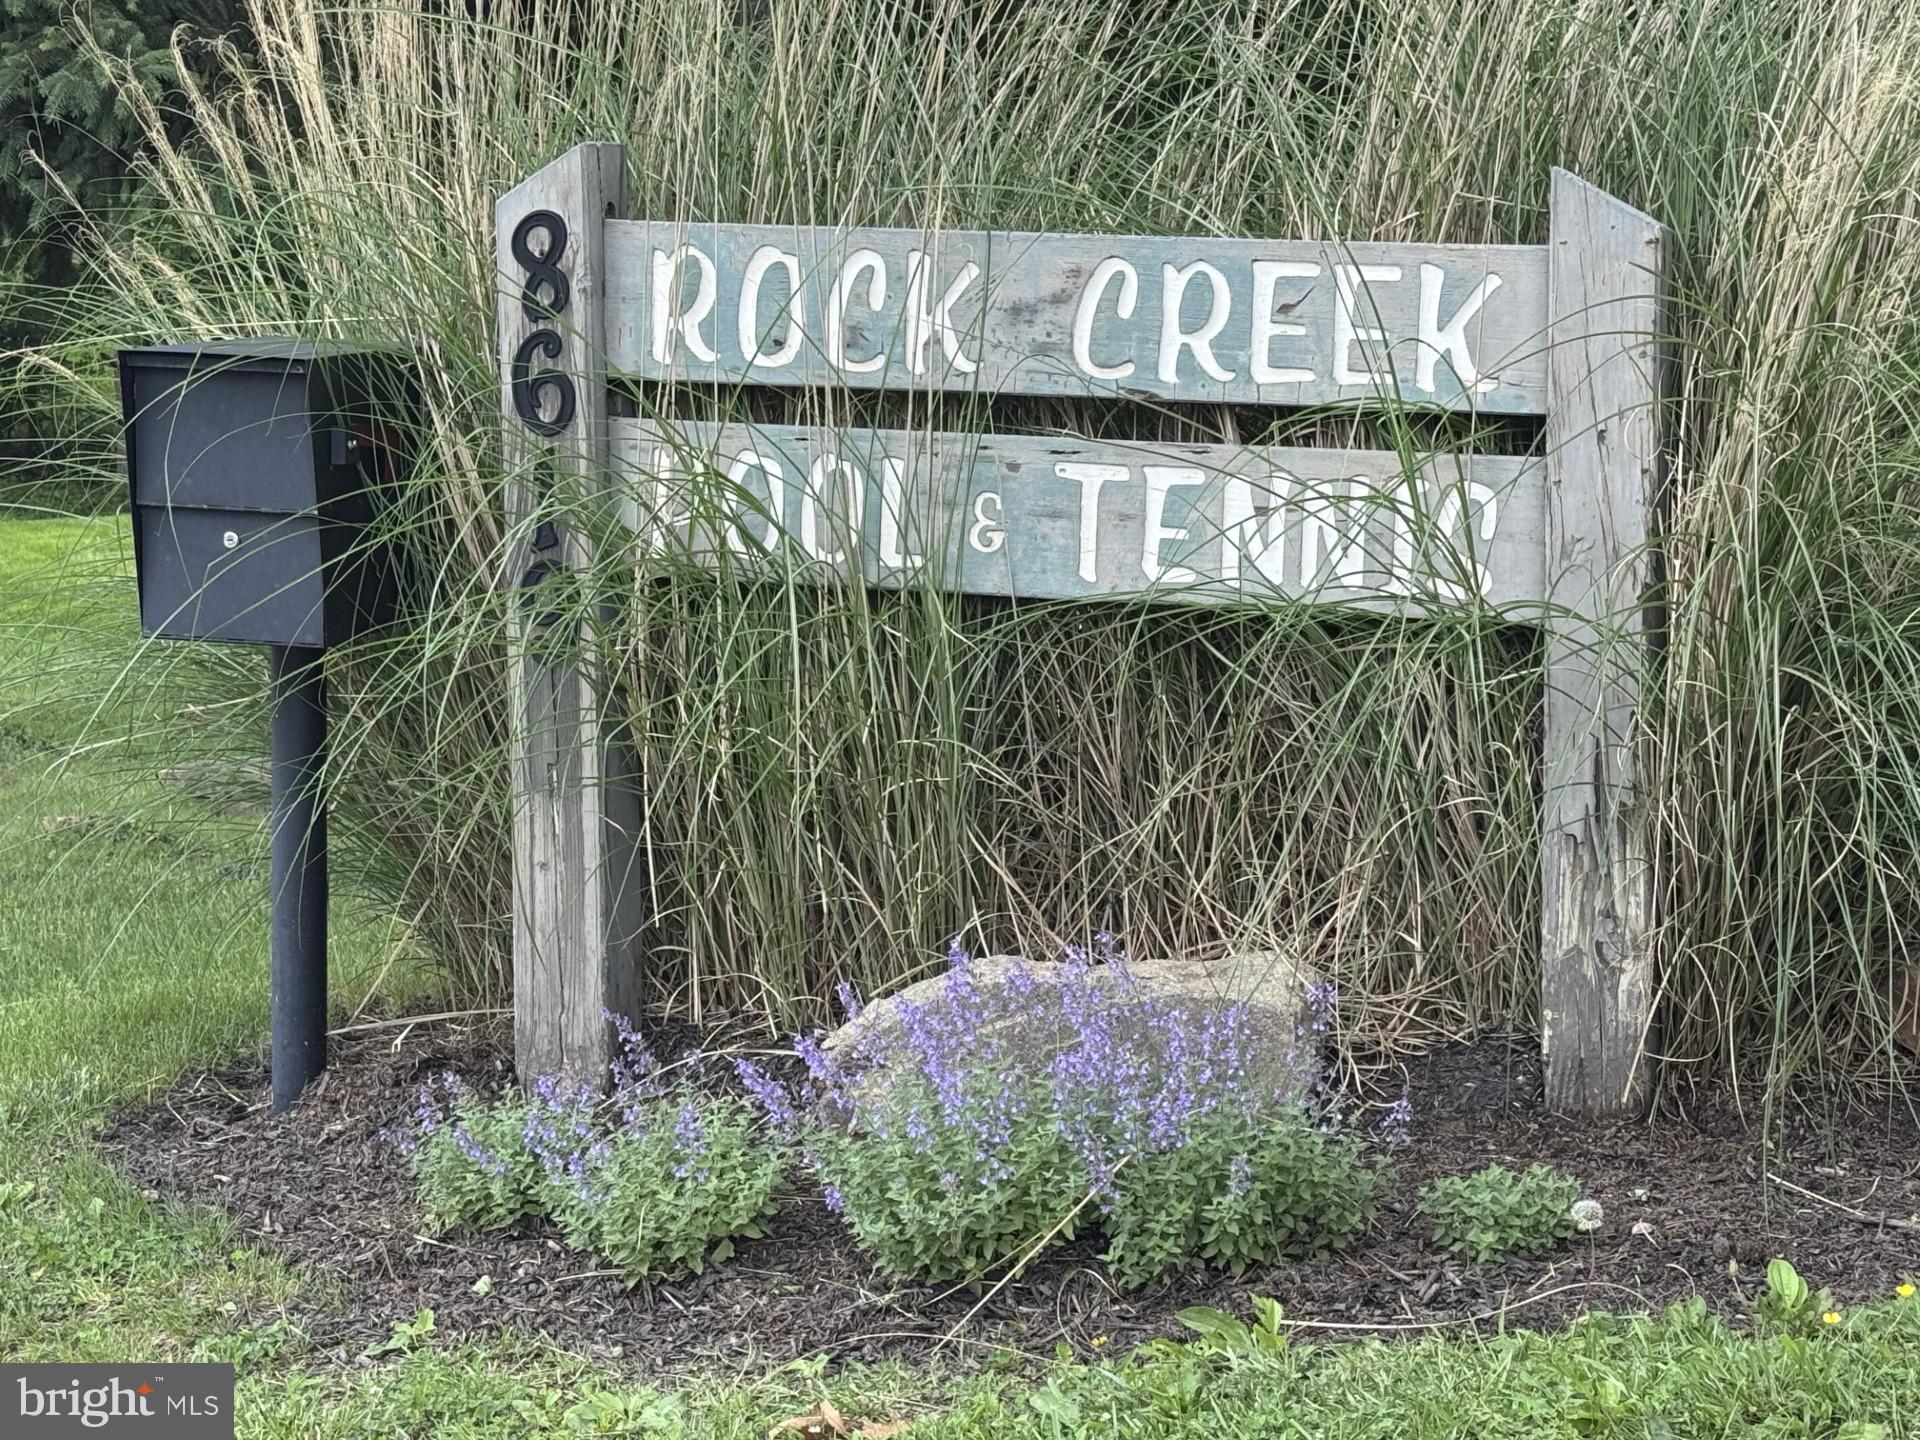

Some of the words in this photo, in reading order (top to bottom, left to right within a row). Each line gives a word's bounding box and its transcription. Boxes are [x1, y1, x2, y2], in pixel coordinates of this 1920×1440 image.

[652, 244, 984, 375] ROCK
[1073, 256, 1503, 393] CREEK
[651, 446, 926, 566] POOL
[969, 491, 1004, 553] &
[1054, 461, 1498, 601] TENNIS
